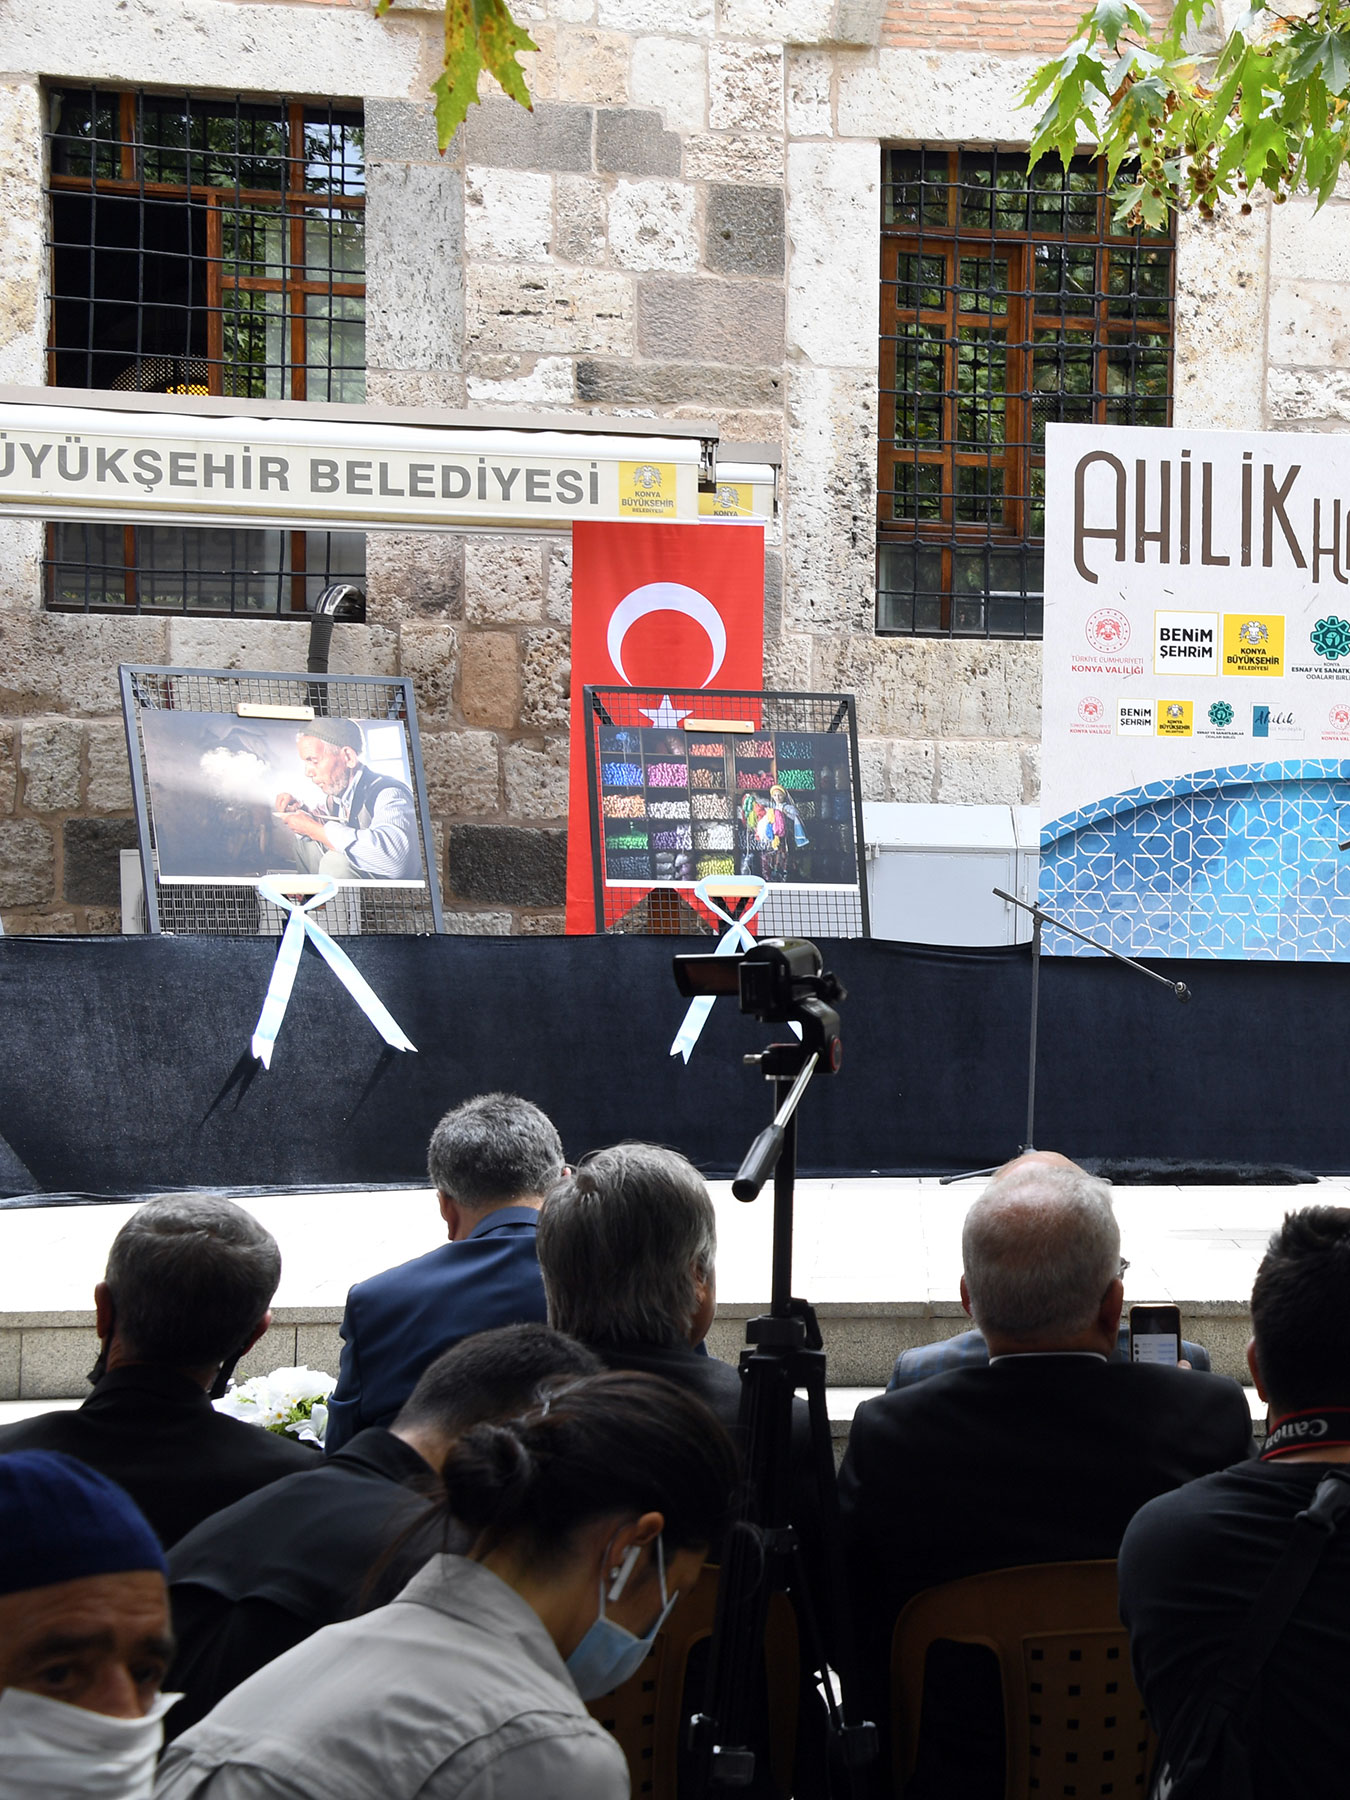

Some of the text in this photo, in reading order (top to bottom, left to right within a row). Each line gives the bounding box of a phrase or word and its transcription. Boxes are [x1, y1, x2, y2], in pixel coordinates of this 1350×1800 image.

[310, 457, 599, 505] BELEDİYESİ
[634, 490, 661, 498] KONYA
[621, 497, 674, 508] BÜYÜKŞEHİR
[1074, 449, 1307, 585] AHİLİK
[1240, 647, 1267, 655] KONYA
[1226, 654, 1280, 665] BÜYÜKŞEHİR
[1071, 664, 1103, 673] KONYA
[1264, 1418, 1329, 1450] Canon
